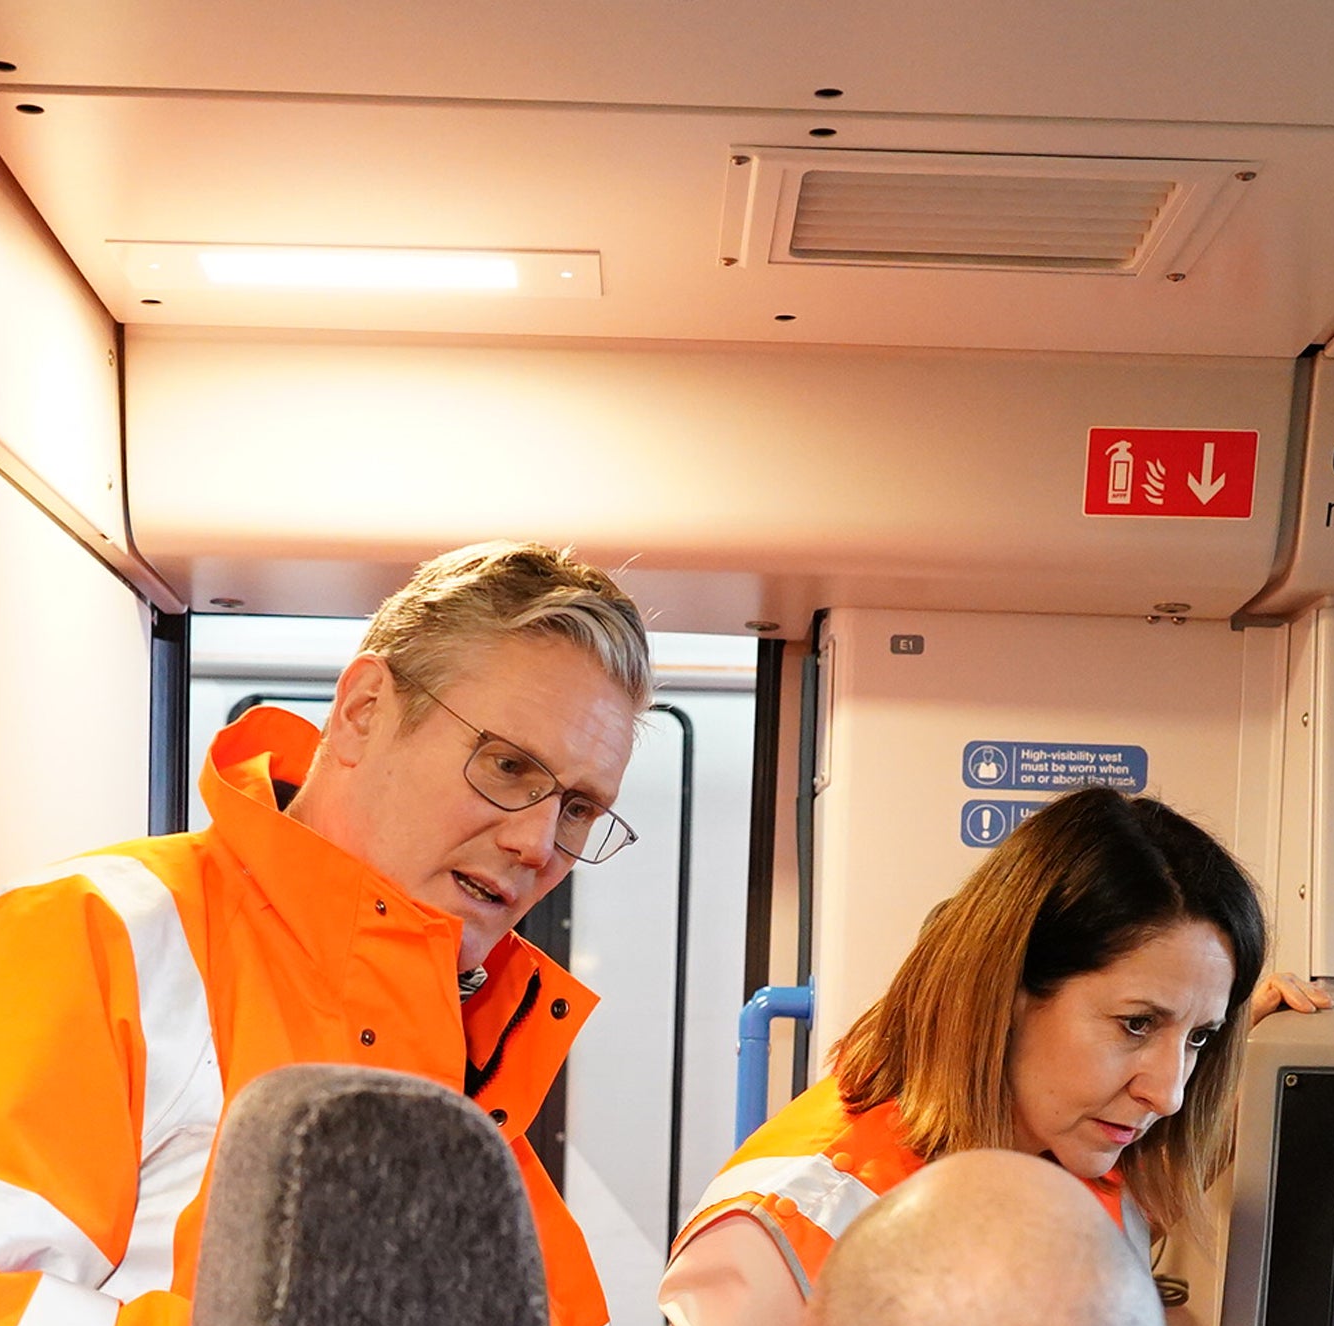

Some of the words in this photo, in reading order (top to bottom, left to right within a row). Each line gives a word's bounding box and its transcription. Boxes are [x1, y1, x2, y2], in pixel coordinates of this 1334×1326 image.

[1020, 749, 1097, 763] High-visibility
[1098, 752, 1122, 763] vest
[1020, 762, 1049, 772] must
[1051, 762, 1066, 773] be
[1068, 764, 1097, 774] worn
[1098, 764, 1129, 775] when
[1020, 775, 1035, 784] on
[1037, 775, 1050, 784] or
[1052, 775, 1084, 786] about
